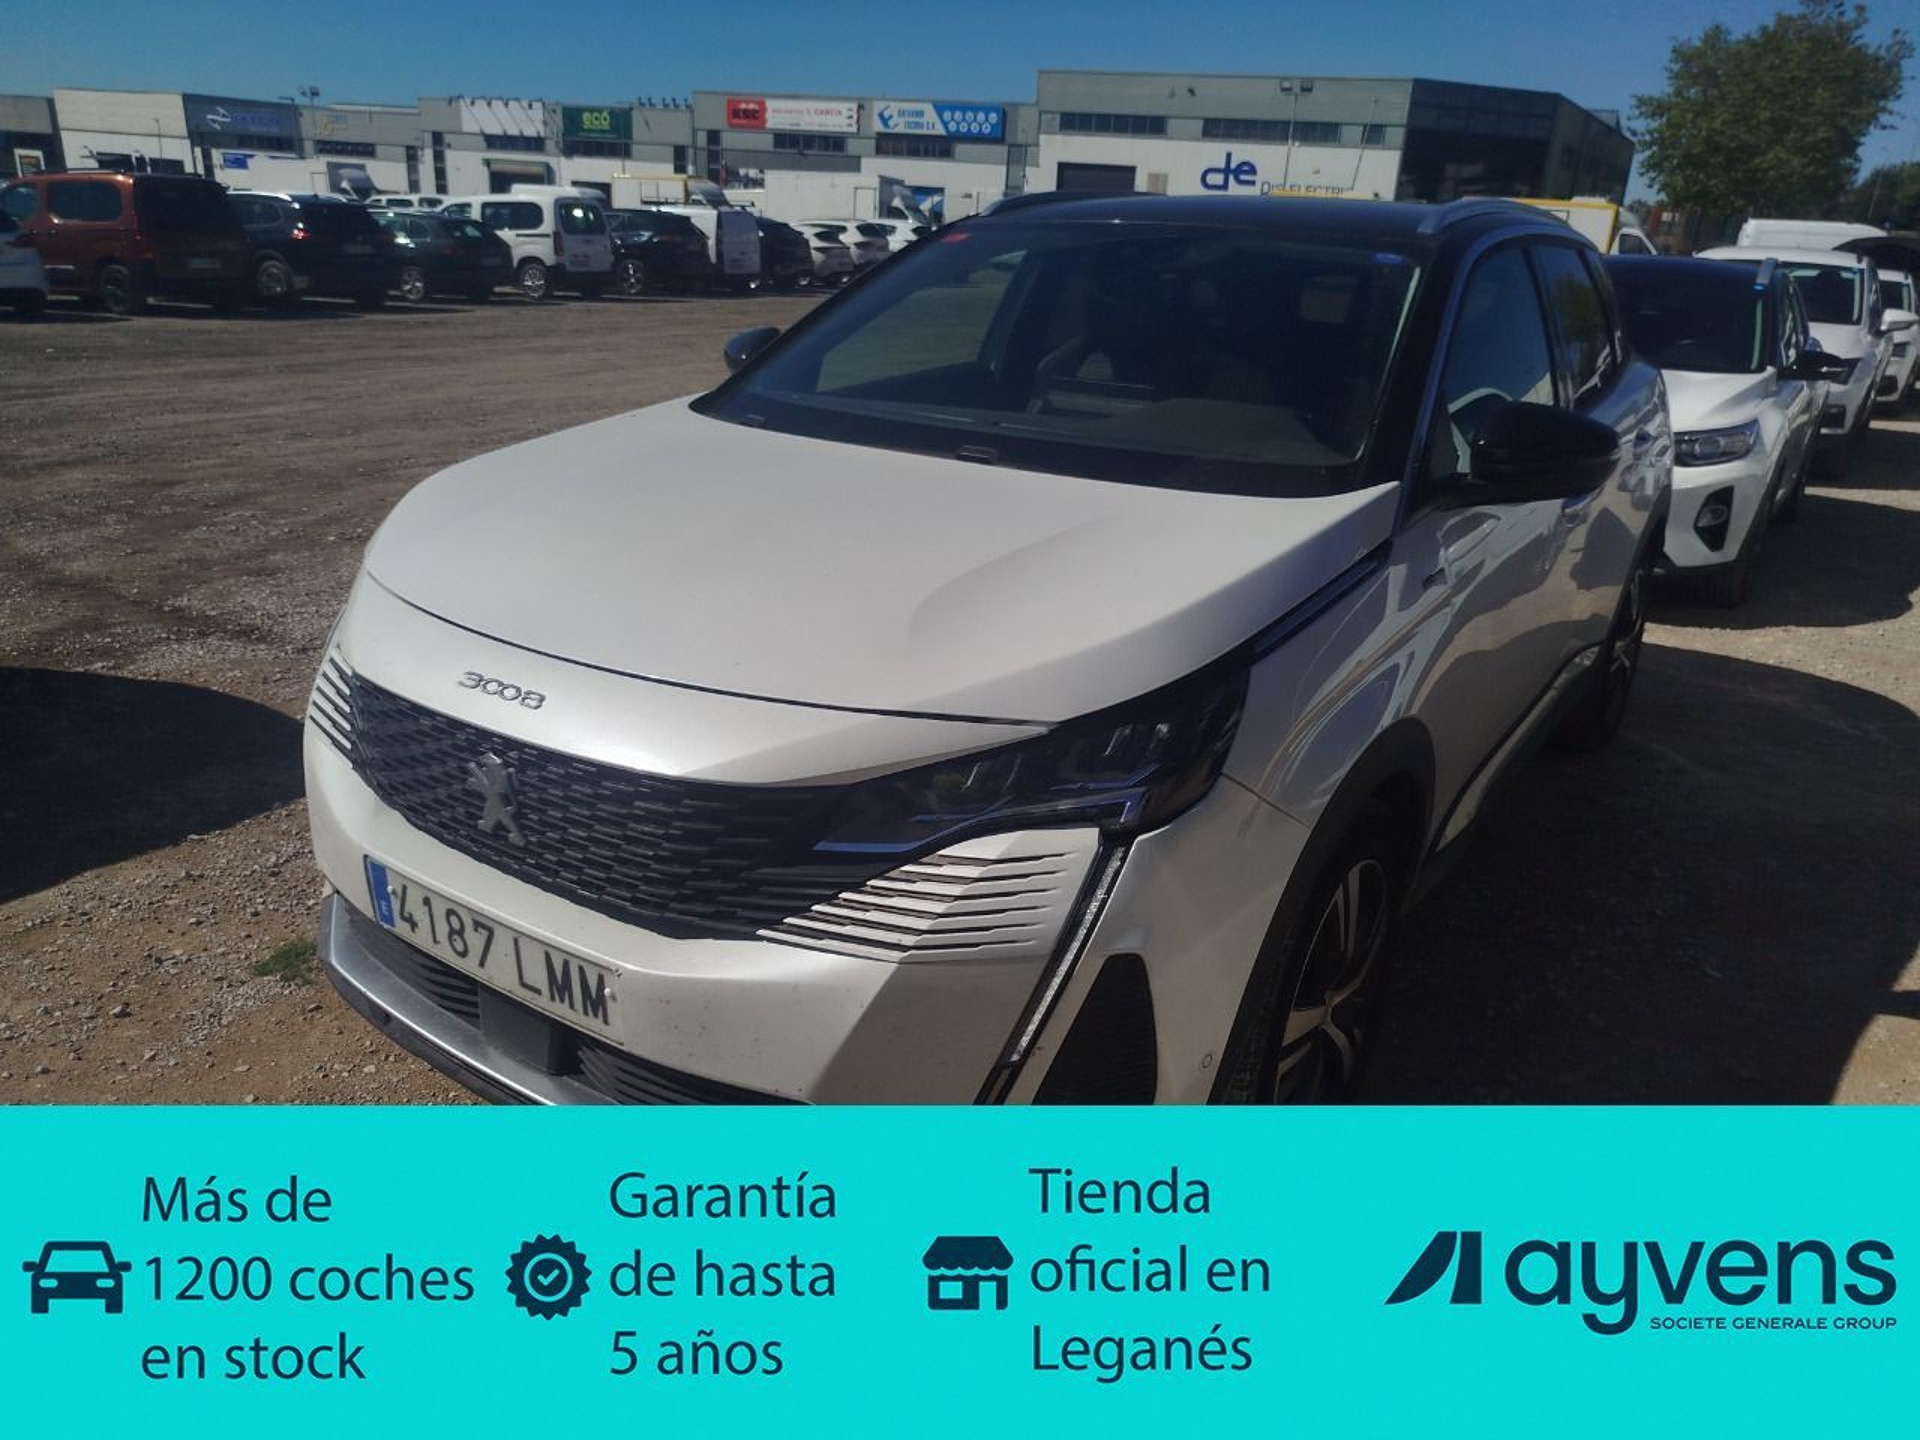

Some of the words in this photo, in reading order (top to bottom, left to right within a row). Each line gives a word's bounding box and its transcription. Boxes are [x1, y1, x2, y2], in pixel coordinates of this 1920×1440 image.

[458, 671, 546, 710] 3008
[398, 884, 495, 968] 4187
[513, 937, 610, 1025] LMM
